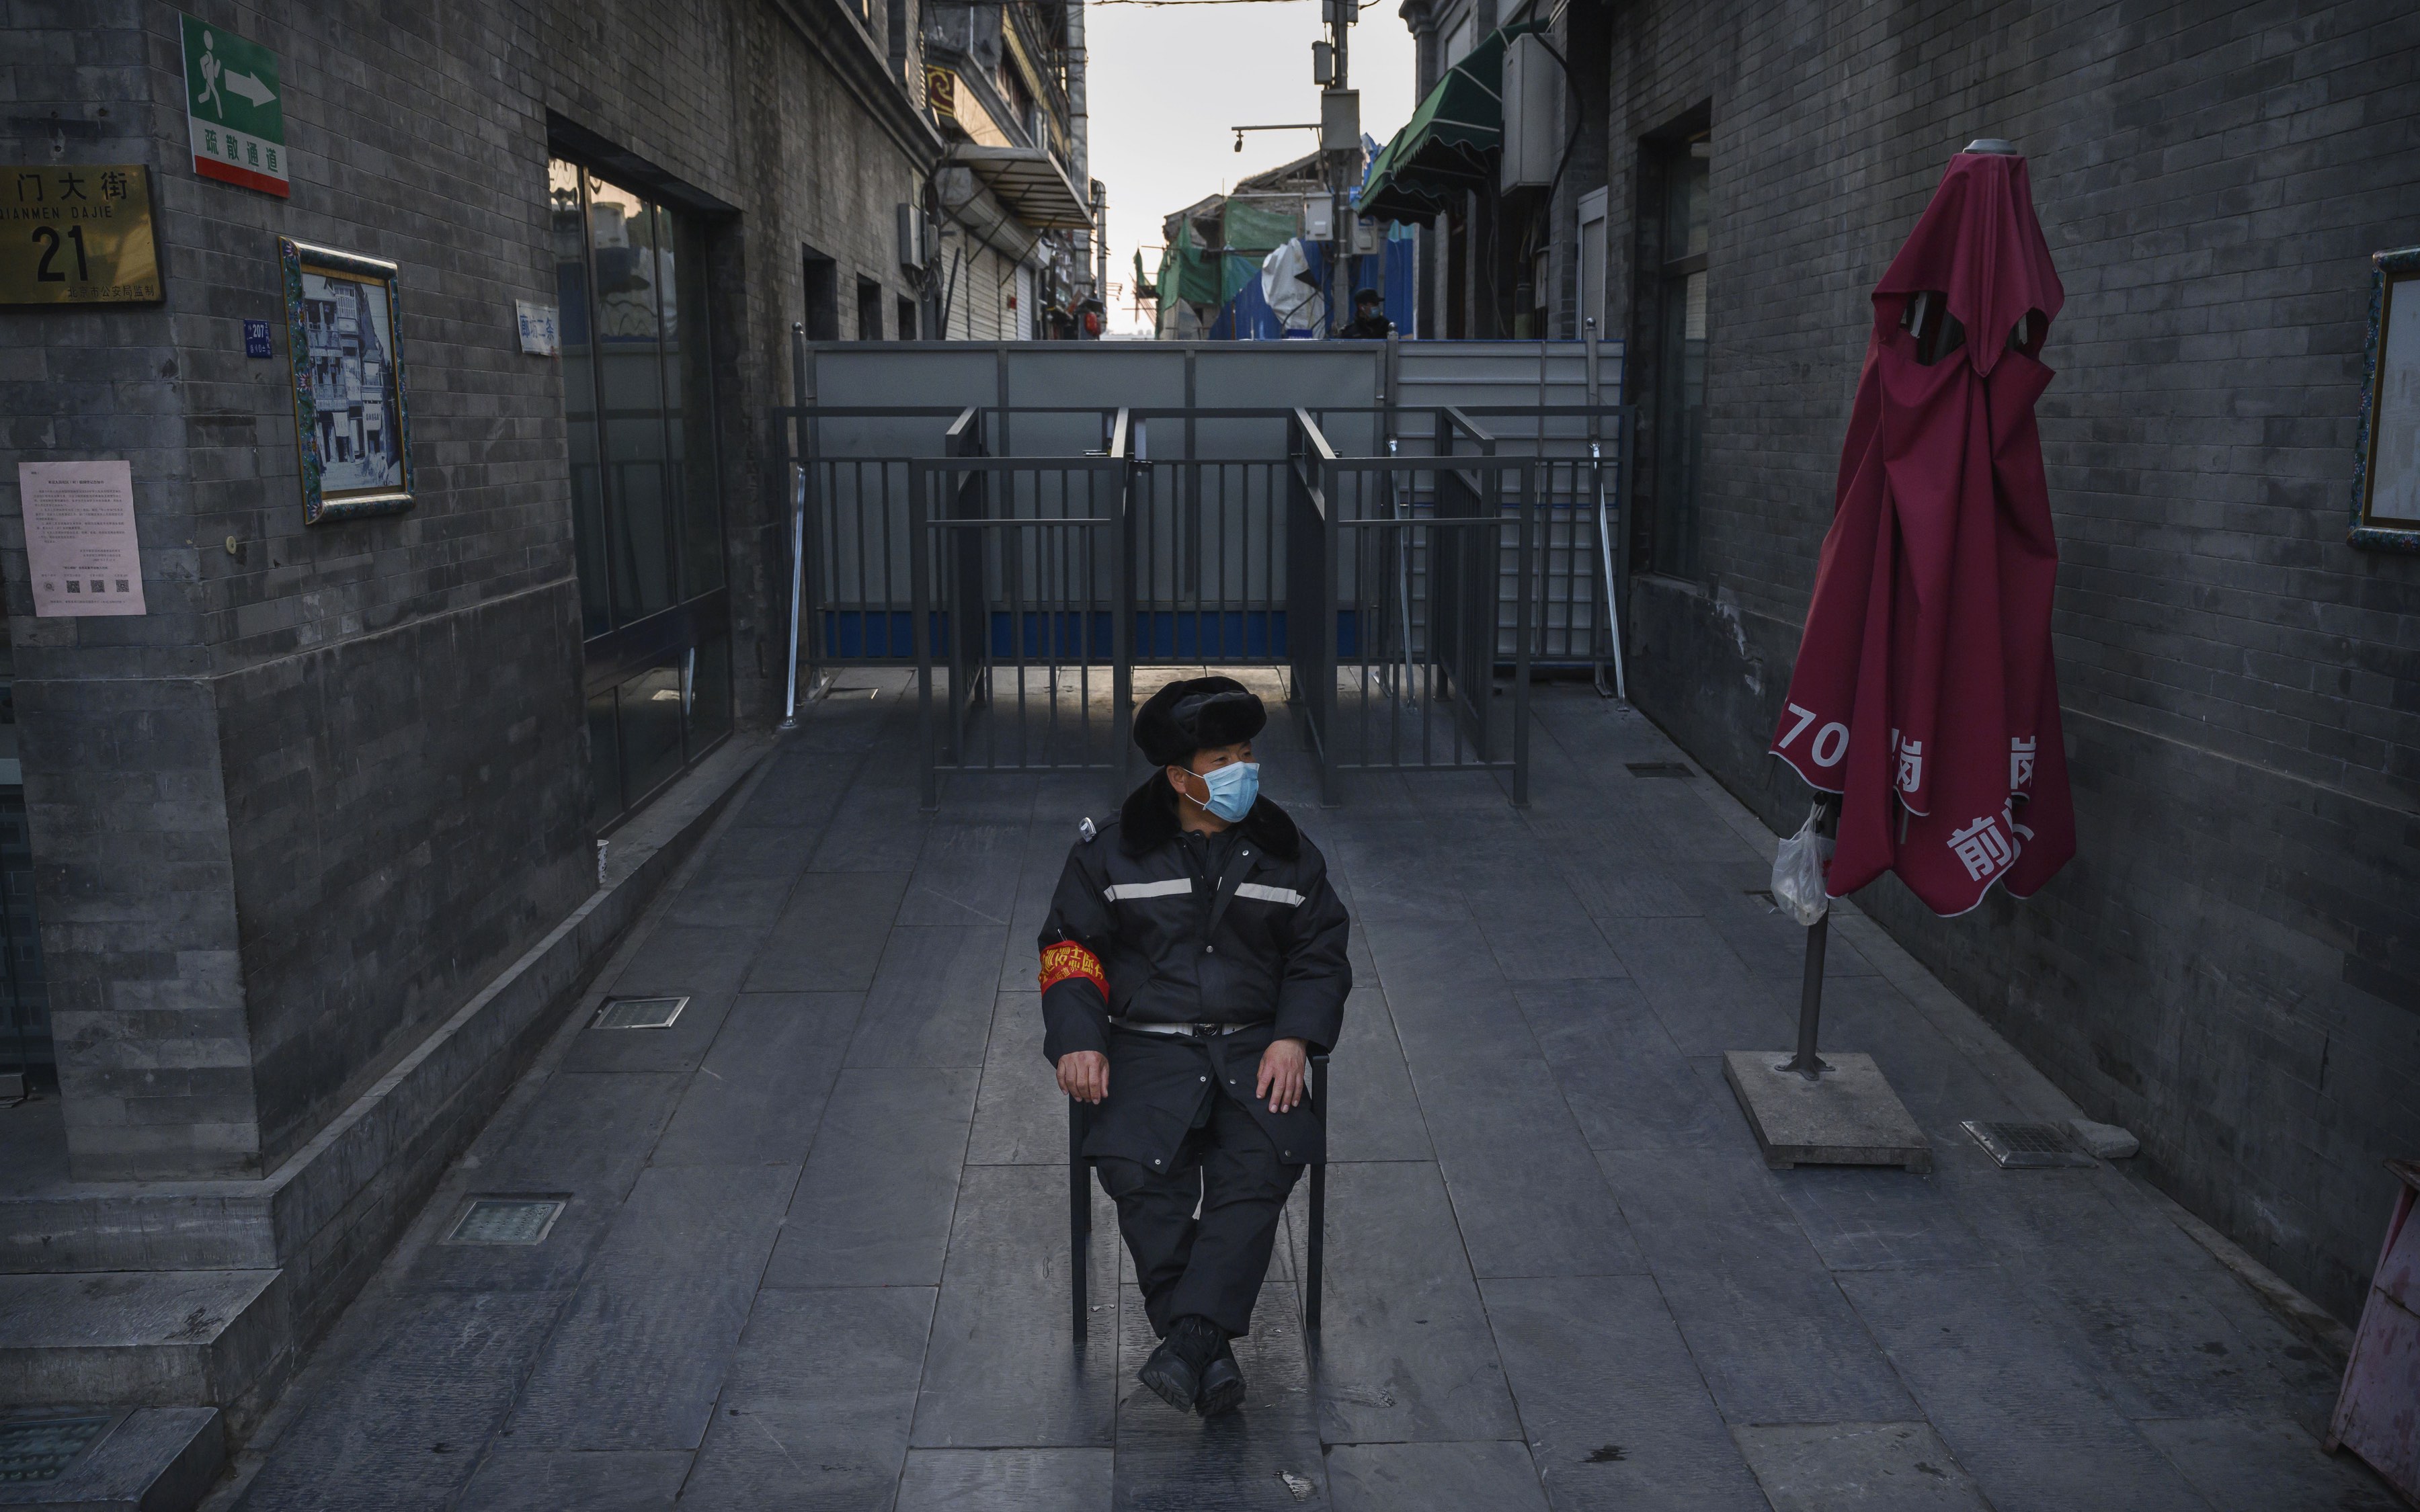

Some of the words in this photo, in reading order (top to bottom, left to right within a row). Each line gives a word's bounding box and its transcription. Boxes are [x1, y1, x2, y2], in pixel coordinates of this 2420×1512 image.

[204, 128, 278, 173] 疏散通道
[17, 171, 127, 201] 门大街
[71, 206, 113, 218] DAJIE
[32, 225, 88, 282] 21
[67, 284, 155, 298] 北京市公安局监制
[252, 324, 264, 338] 207
[520, 314, 555, 341] 廊坊二条
[1778, 702, 1849, 768] 70
[1946, 797, 2013, 882] 前
